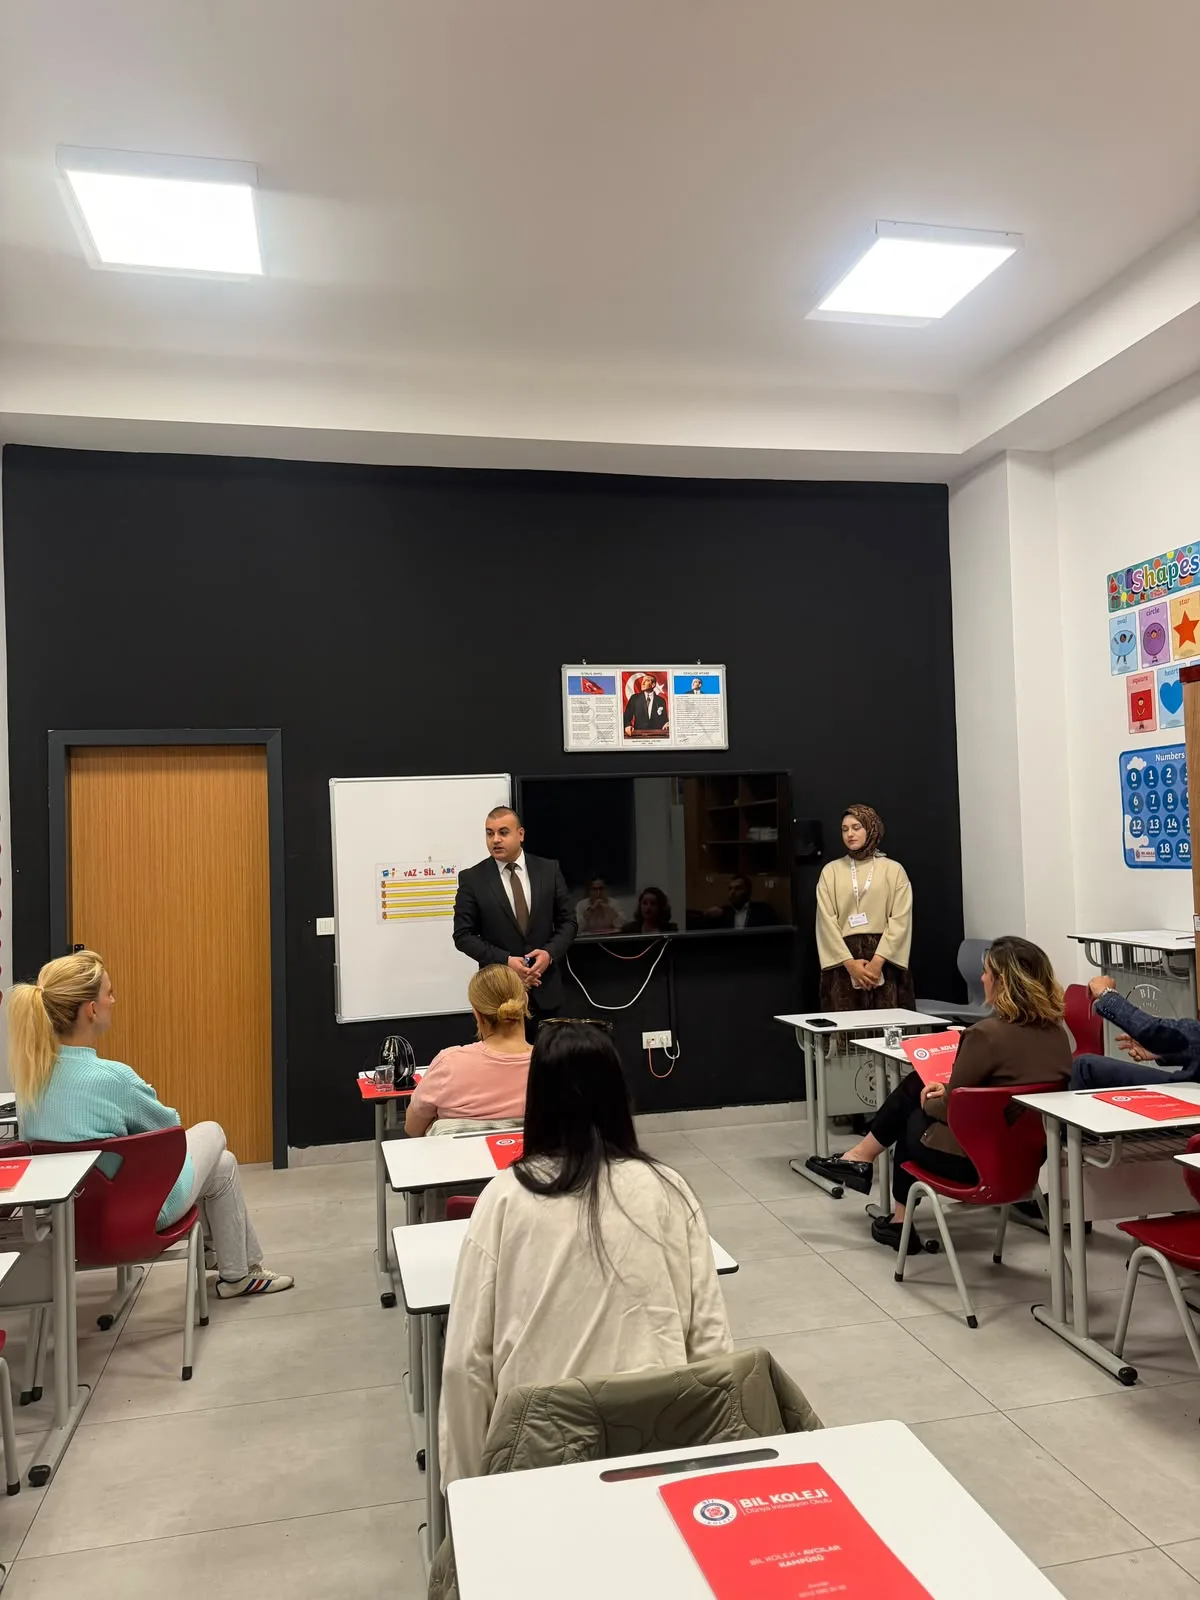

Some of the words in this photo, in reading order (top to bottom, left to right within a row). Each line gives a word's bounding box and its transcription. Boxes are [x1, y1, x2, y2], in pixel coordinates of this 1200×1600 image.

[1132, 554, 1200, 592] Shapes
[1146, 607, 1160, 617] circle
[1164, 668, 1179, 676] heart
[1155, 752, 1185, 762] Numbers
[1131, 772, 1137, 782] 0
[1149, 770, 1154, 780] 1
[1166, 768, 1172, 778] 2
[1133, 796, 1139, 806] 6
[1150, 794, 1155, 804] 7
[1167, 793, 1173, 803] 8
[1132, 820, 1142, 830] 12
[1149, 819, 1159, 829] 13
[1167, 818, 1177, 828] 14
[1160, 843, 1170, 853] 18
[1178, 843, 1189, 853] 19
[403, 869, 417, 877] YAZ
